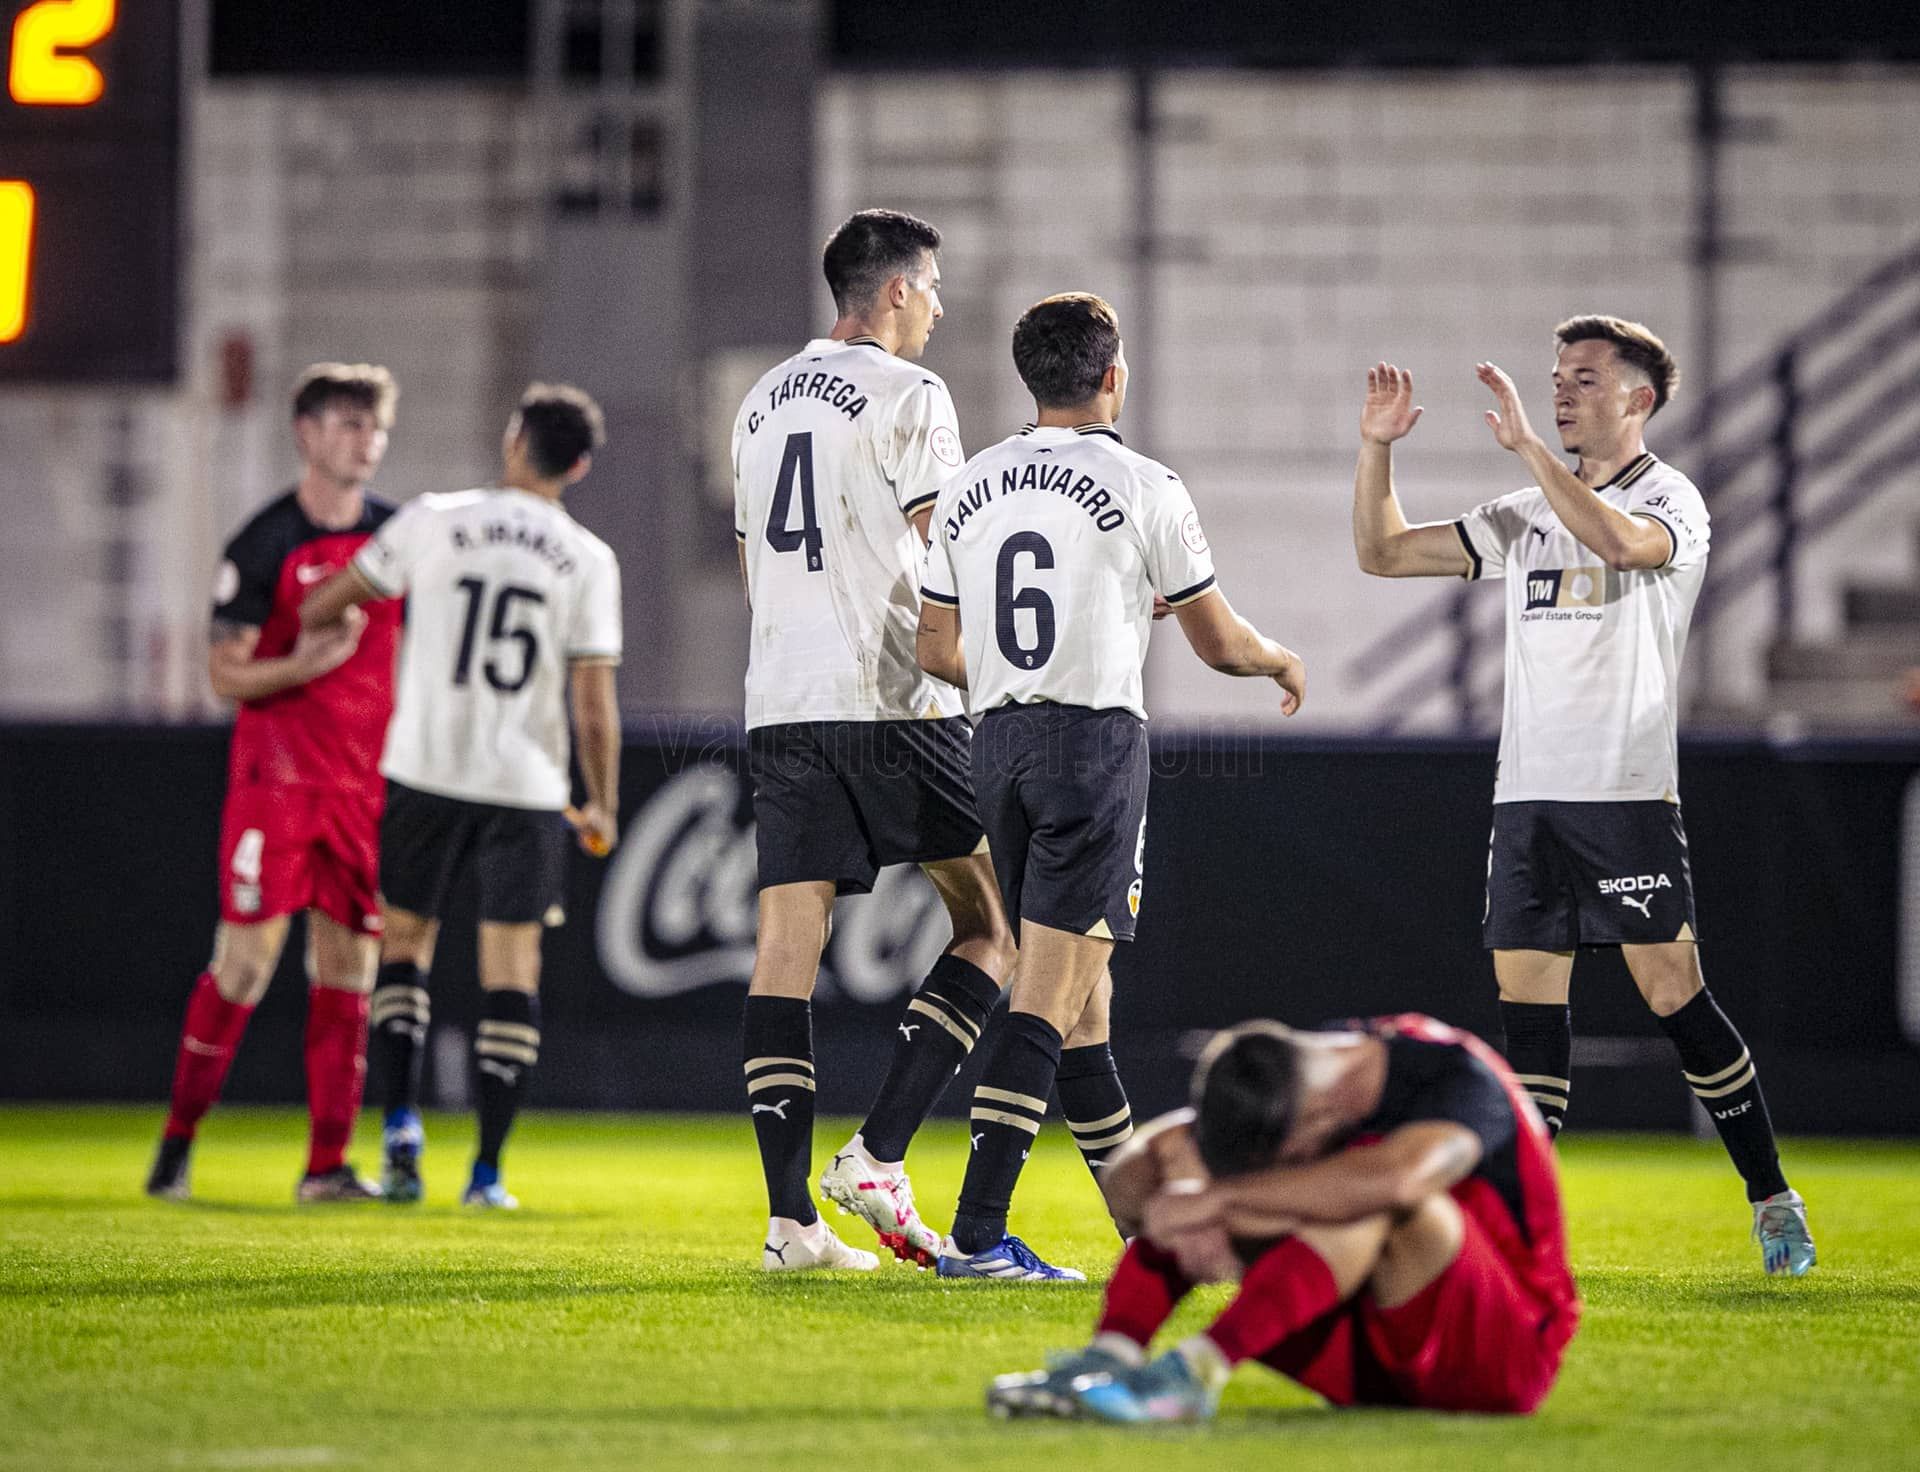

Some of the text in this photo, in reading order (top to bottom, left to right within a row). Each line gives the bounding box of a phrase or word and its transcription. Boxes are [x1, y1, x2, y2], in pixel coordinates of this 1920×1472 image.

[748, 411, 765, 435] C.
[765, 431, 824, 573] 4
[944, 463, 1126, 542] JAVI NAVARRO
[995, 530, 1056, 670] 6
[1528, 579, 1555, 603] TM
[1545, 610, 1573, 621] Estate
[1574, 611, 1603, 622] Group
[453, 574, 546, 693] 15
[1597, 872, 1673, 895] SKODA
[1714, 1099, 1753, 1120] VCF
